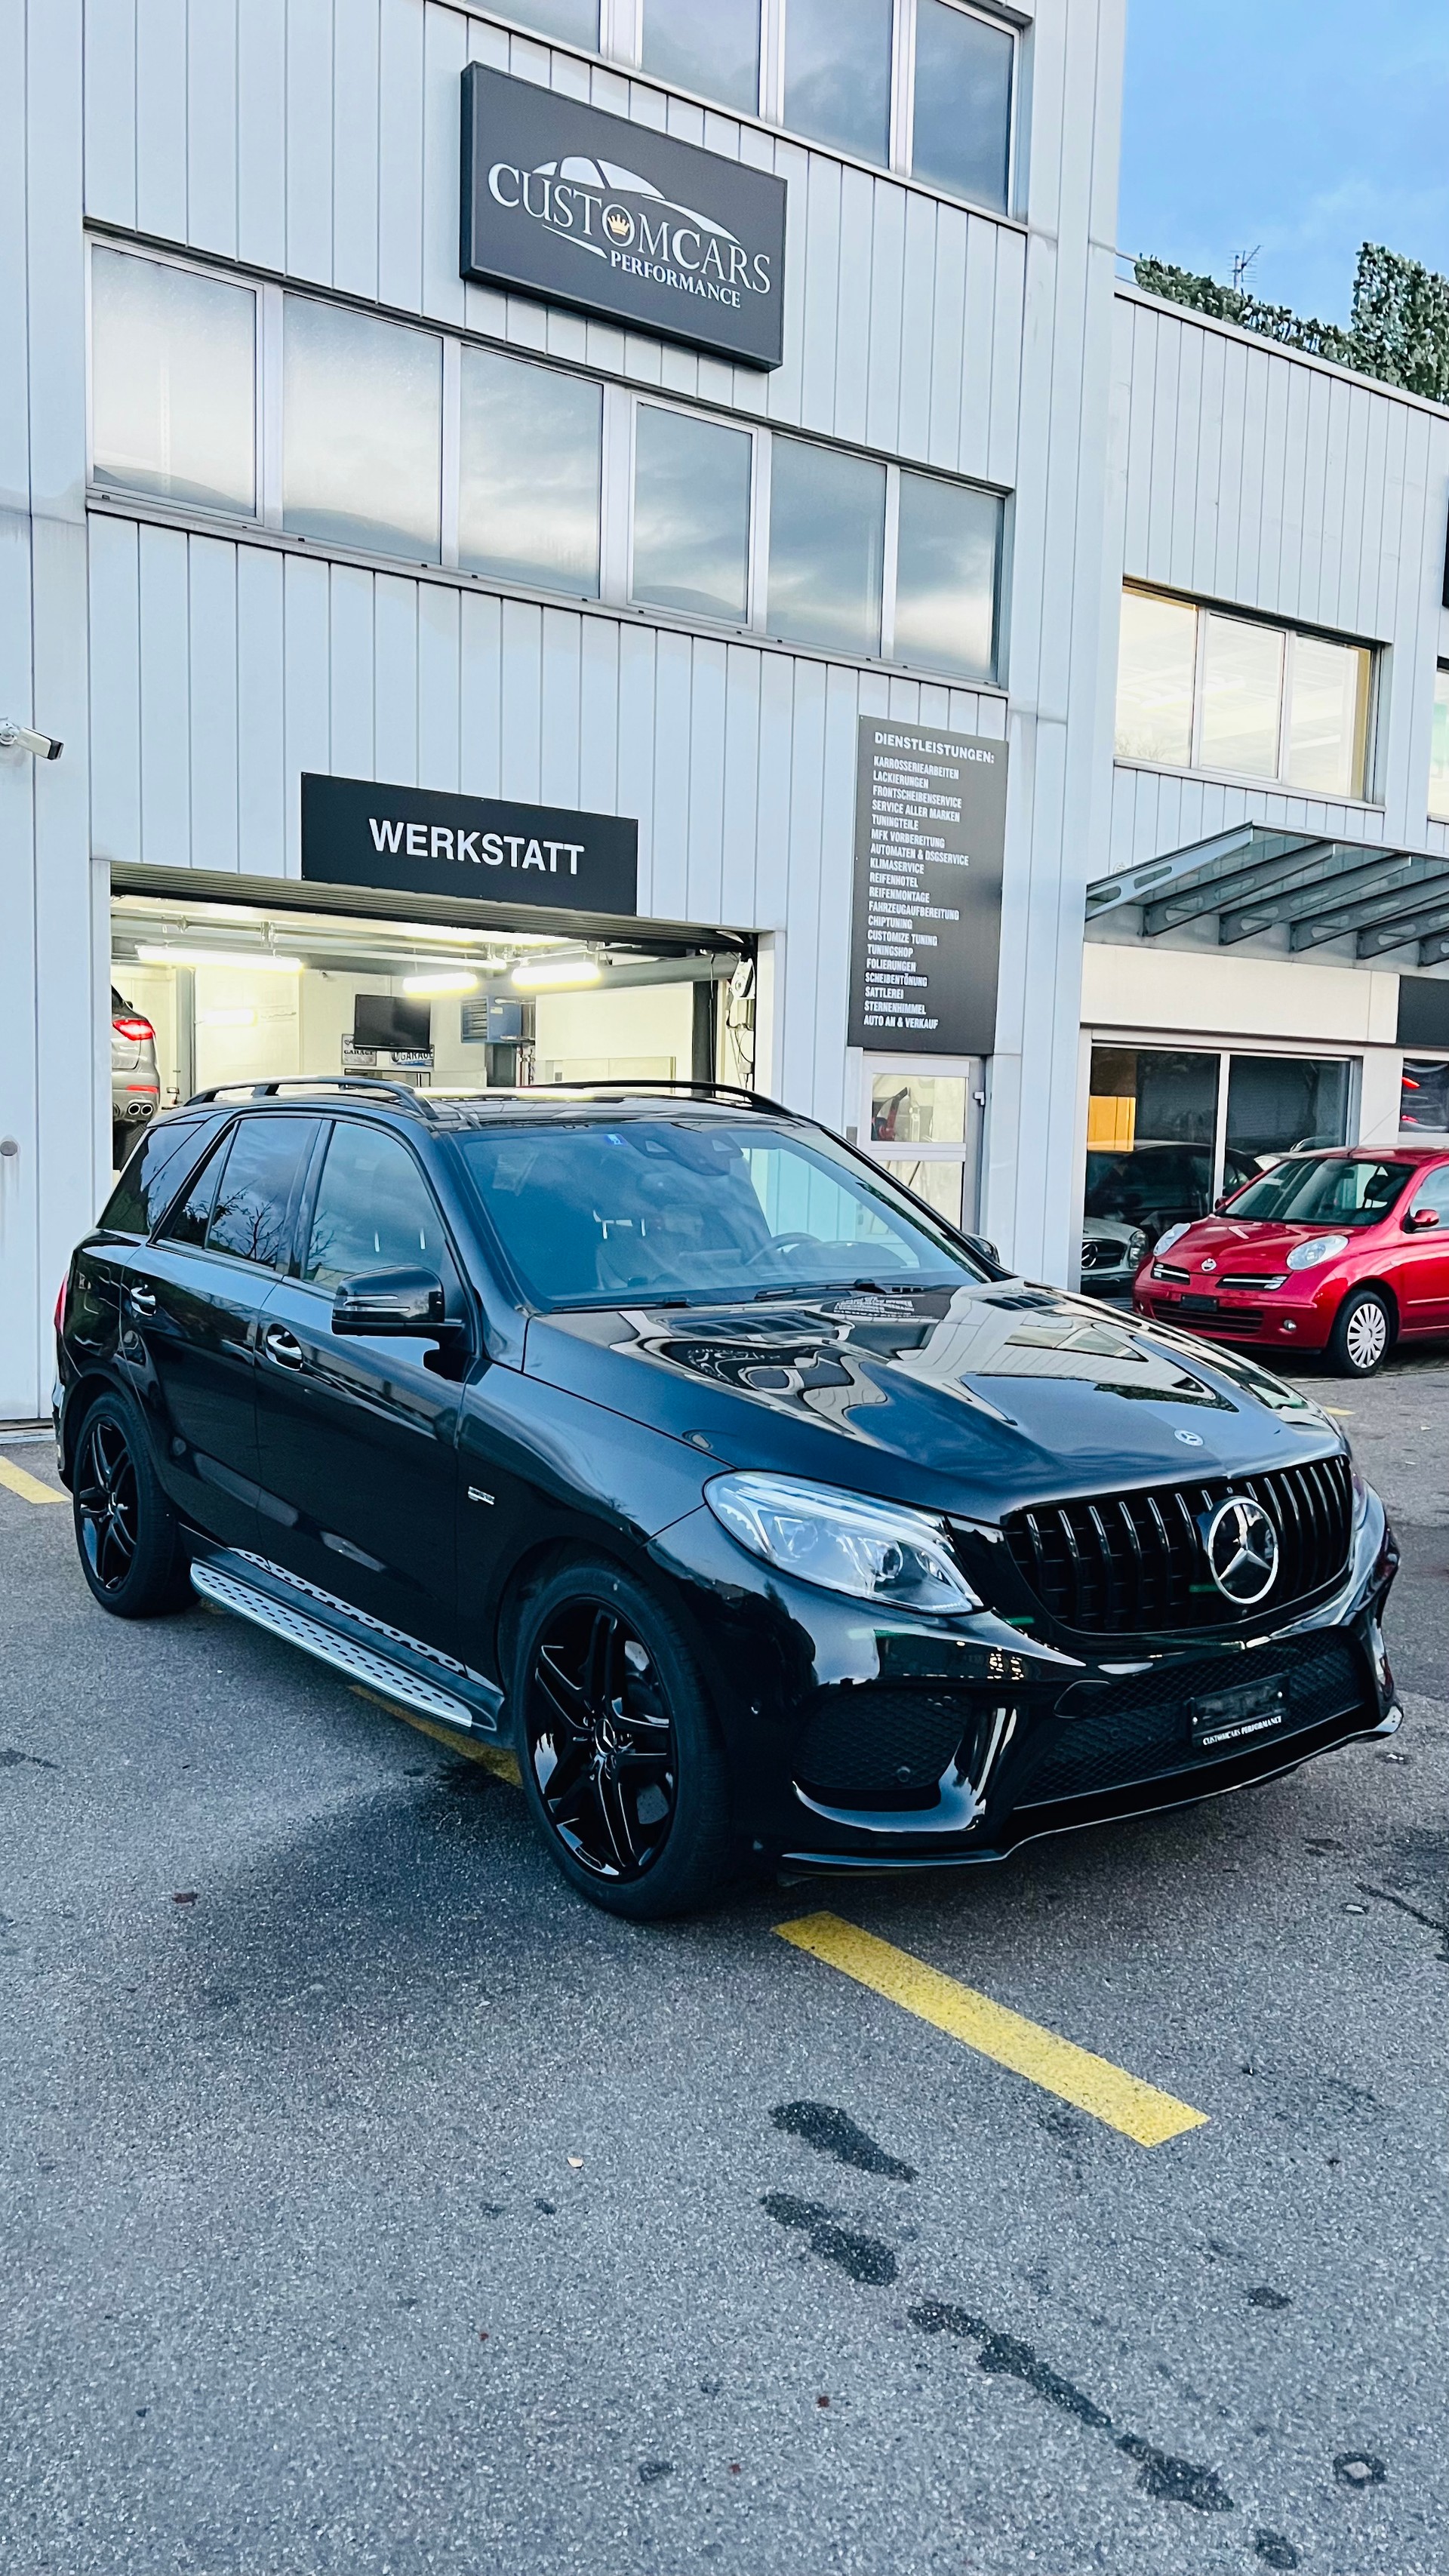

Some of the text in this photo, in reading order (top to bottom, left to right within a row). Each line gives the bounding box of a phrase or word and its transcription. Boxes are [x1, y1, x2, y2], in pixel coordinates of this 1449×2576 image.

[488, 162, 771, 294] CUSTOMCARS
[610, 250, 740, 308] PERFORMANCE
[875, 731, 995, 764] DIENSTLEISTUNGEN:
[873, 756, 959, 780] KARROSSERIEARBEITEN
[873, 770, 929, 789] LACKIERUNGEN
[872, 785, 962, 808] FRONTSCHEIBENSERVICE
[872, 799, 961, 823] SERVICE ALLER MARKEN
[872, 814, 918, 831] TUNINGTEILE
[368, 817, 585, 875] WERKSTATT
[871, 829, 945, 848] MFK VORBEREITUNG
[870, 843, 969, 866] AUTOMATEN & DSGSERVICE
[870, 857, 924, 875] KLIMASERVICE
[869, 872, 918, 888] REIFENHOTEL
[869, 886, 930, 903] REIFENMONTAGE
[869, 900, 959, 920] FAHRZEUGAUFBEREITUNG
[868, 915, 912, 930] CHIPTUNING
[867, 929, 938, 946] CUSTOMIZE TUNING
[867, 943, 913, 958] TUNINGSHOP
[866, 958, 916, 972] FOLIERUNGEN
[865, 972, 928, 987] SCHEIBENTÖNUNG
[865, 986, 904, 999] SATTLEREI
[864, 1000, 926, 1015] STERNENHIMMEL
[863, 1015, 939, 1029] AUTO AN & VERKAUF
